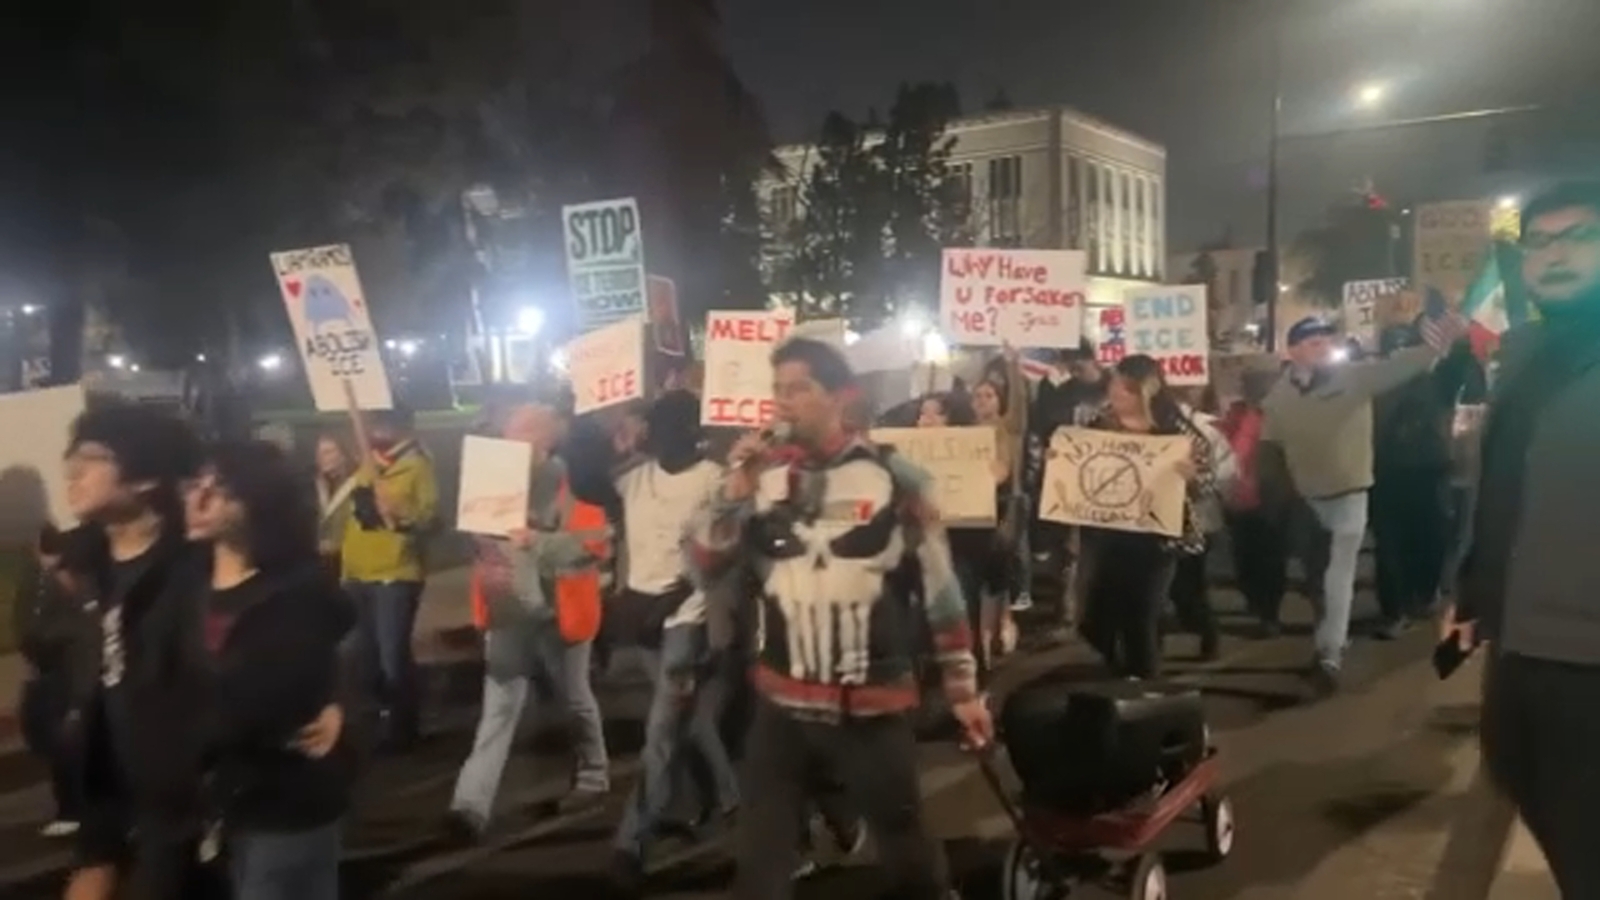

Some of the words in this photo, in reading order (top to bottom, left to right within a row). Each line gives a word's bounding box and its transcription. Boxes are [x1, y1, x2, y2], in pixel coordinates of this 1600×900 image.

[568, 206, 635, 260] STOP
[997, 257, 1048, 284] Have
[1133, 294, 1196, 320] END
[710, 319, 790, 341] MELT
[1134, 328, 1193, 351] ICE
[327, 354, 364, 375] ICE
[597, 369, 635, 402] ICE
[709, 399, 777, 422] ICE
